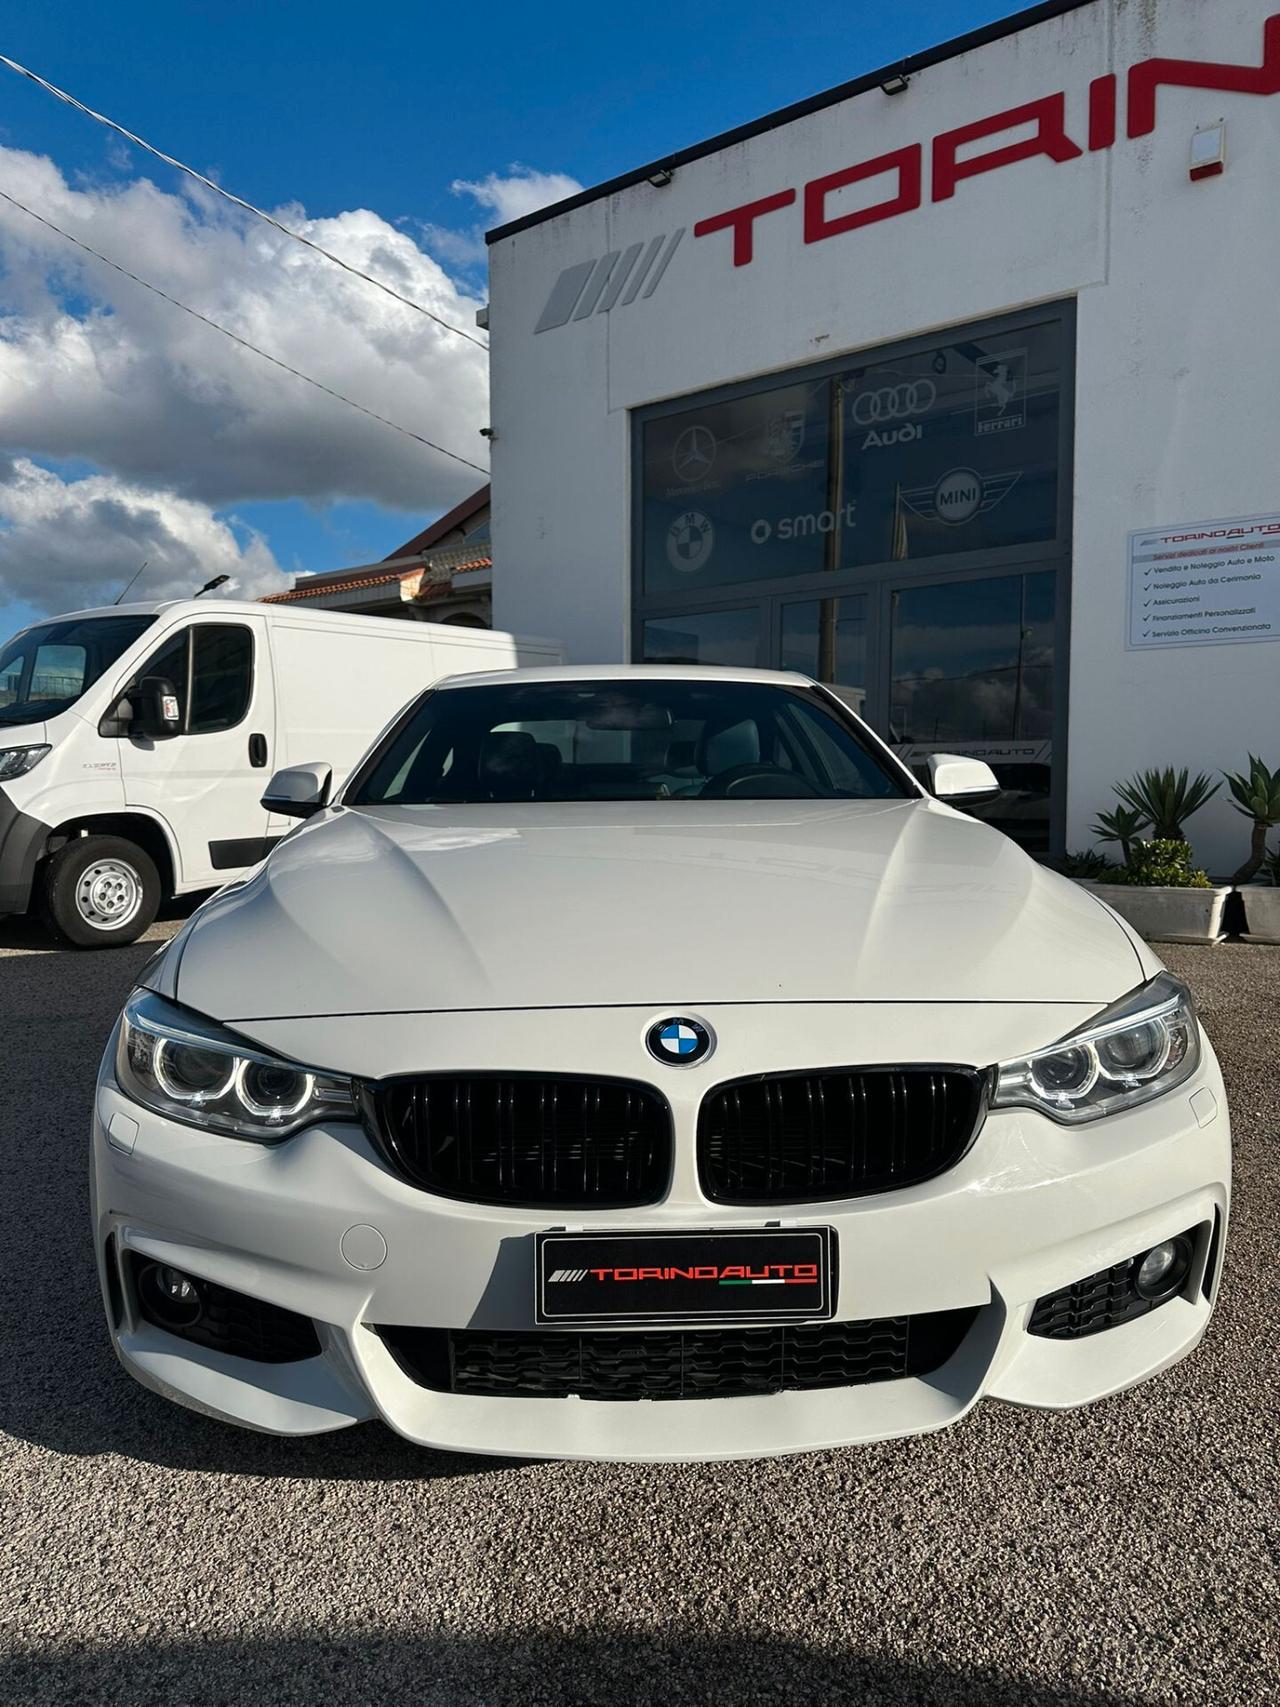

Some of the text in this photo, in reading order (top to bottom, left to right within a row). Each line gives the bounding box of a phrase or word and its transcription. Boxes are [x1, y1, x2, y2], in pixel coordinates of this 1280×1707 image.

[694, 13, 1280, 266] TORIN
[977, 413, 1023, 434] Ferrari
[861, 423, 923, 450] Audi
[939, 486, 977, 507] MINI
[777, 503, 856, 540] smart
[1160, 523, 1280, 543] TORINOAUTO
[1153, 564, 1182, 574] Vendita
[1190, 560, 1226, 570] Noleggio
[1227, 558, 1245, 567] Auto
[1254, 555, 1275, 564] Moto
[1153, 580, 1187, 590] Noleggio
[1189, 578, 1207, 587] Auto
[1220, 573, 1261, 583] Cerimonia
[1153, 596, 1200, 606] Assicurazioni
[1153, 607, 1256, 622] Finanziamenti Personalizzati
[1152, 623, 1271, 638] Servizio Officina Convenzionata
[590, 1264, 817, 1281] TORINOAUTO
